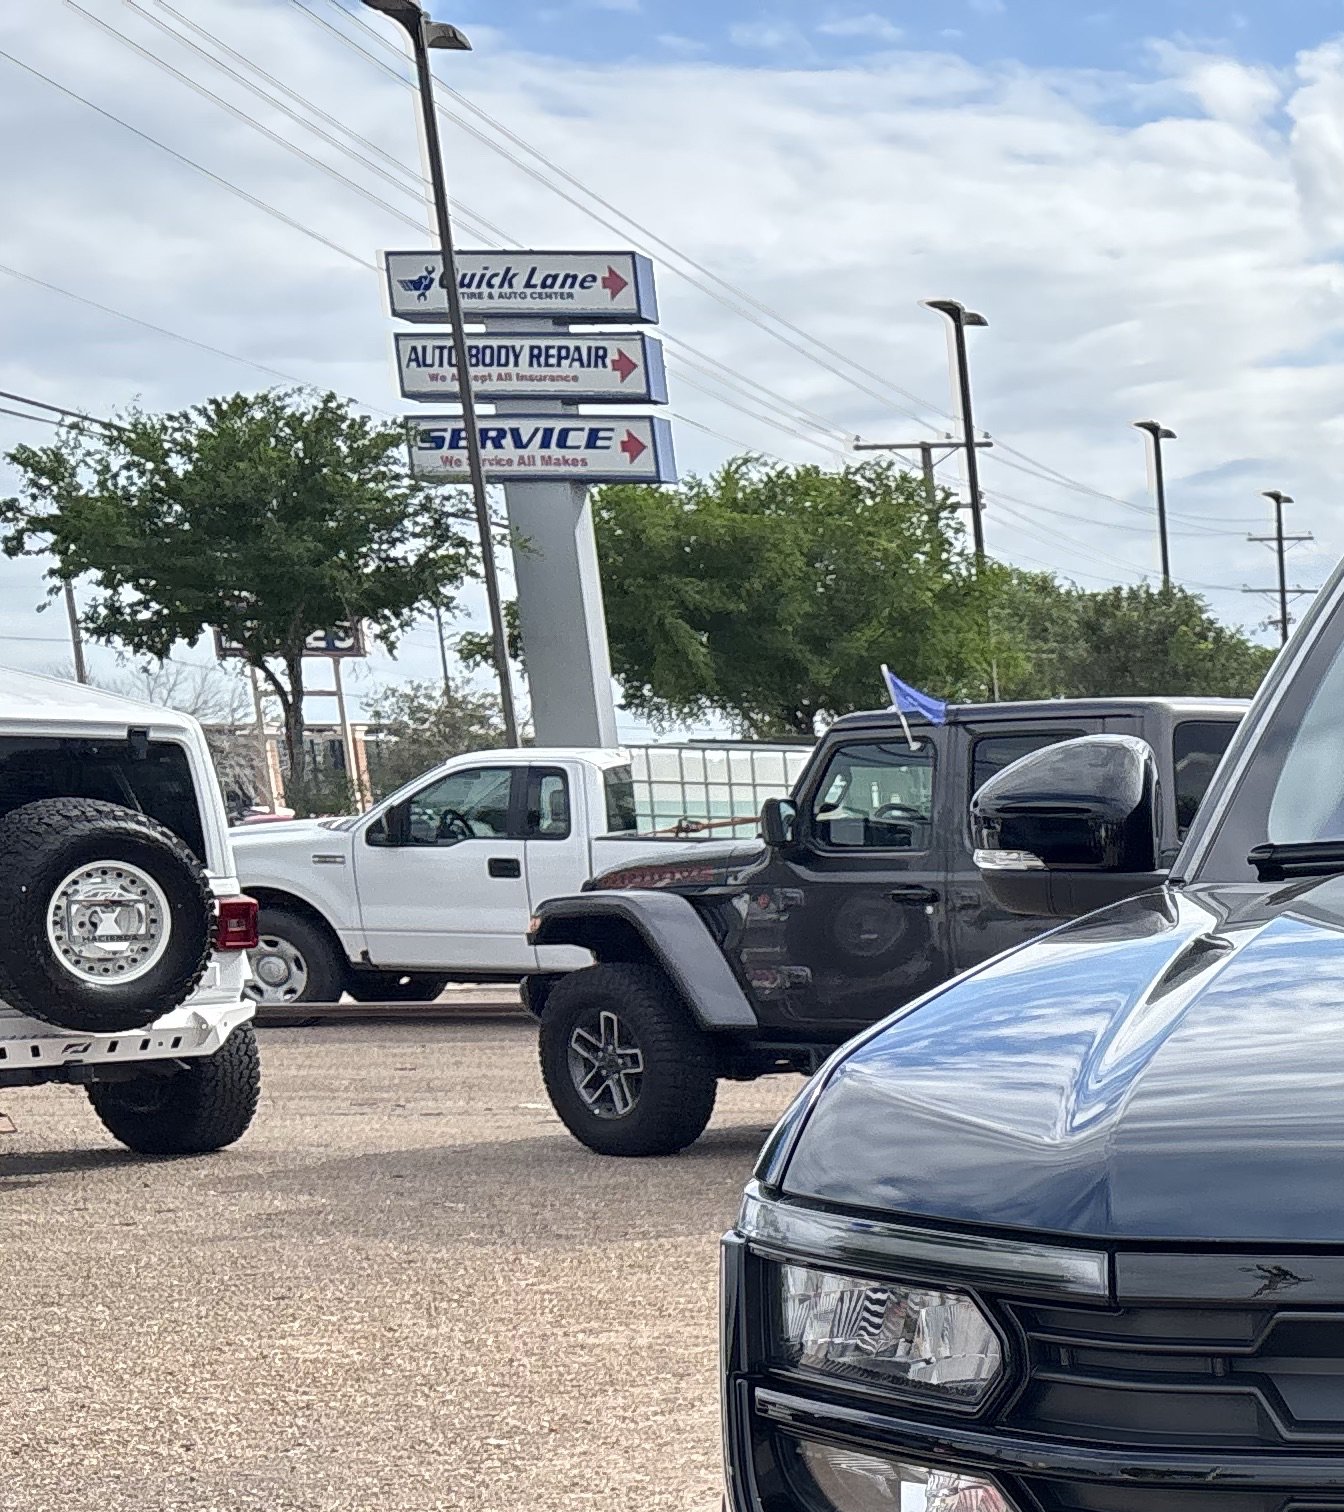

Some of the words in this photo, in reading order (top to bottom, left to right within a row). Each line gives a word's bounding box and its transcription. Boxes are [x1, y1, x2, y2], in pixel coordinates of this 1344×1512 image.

[523, 266, 598, 290] Lane
[460, 291, 485, 300] TIRE
[487, 291, 495, 300] &
[497, 291, 528, 300] AUTO
[529, 291, 575, 300] CENTER
[467, 344, 525, 368] BODY
[528, 344, 608, 369] REPAIR
[427, 372, 448, 383] We
[450, 372, 493, 384] Aept
[496, 372, 513, 382] All
[515, 372, 579, 383] Insurance
[417, 427, 615, 451] SERVICE
[440, 455, 462, 467] We
[464, 454, 514, 467] rvice
[517, 455, 536, 467] All
[540, 454, 589, 467] Makes
